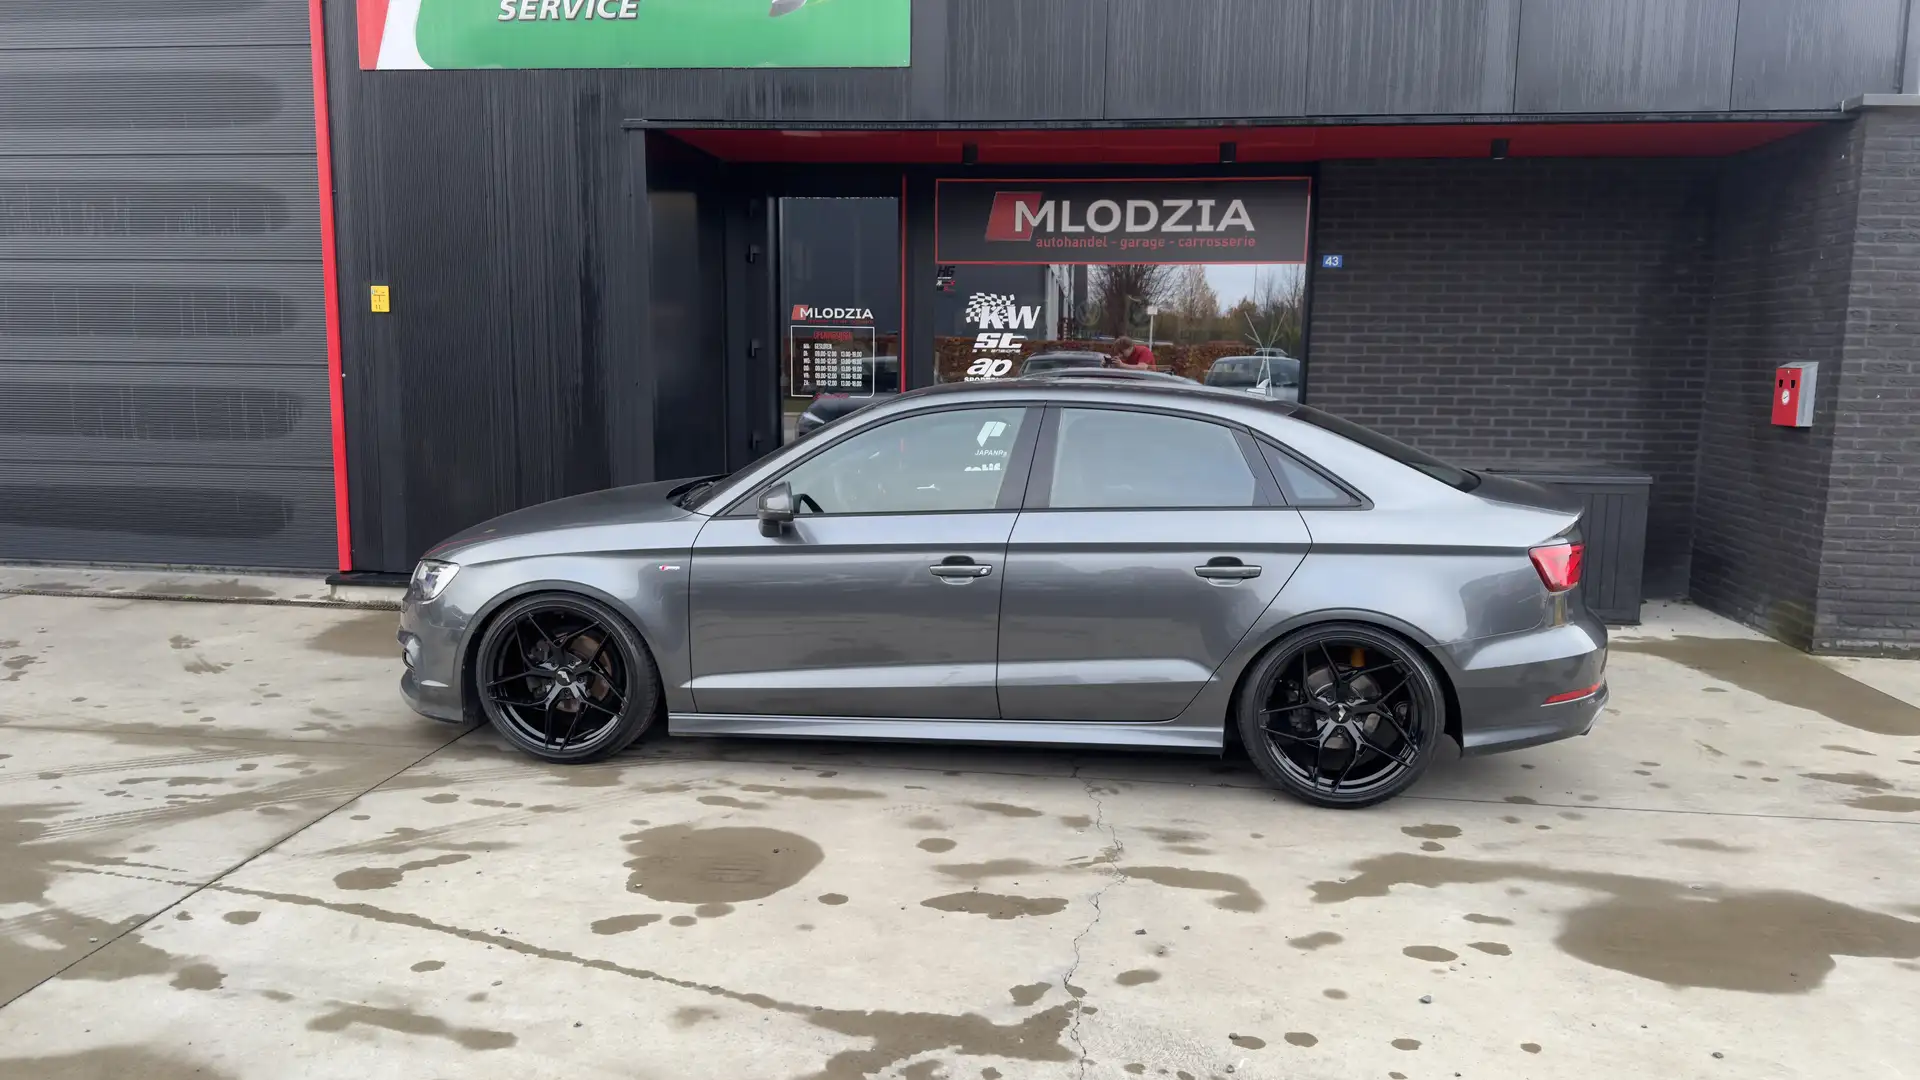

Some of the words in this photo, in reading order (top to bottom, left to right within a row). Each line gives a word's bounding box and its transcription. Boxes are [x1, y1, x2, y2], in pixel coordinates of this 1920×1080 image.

[498, 0, 639, 21] SERVICE
[1014, 199, 1256, 233] MLODZIA
[1036, 236, 1108, 248] autohandel
[1119, 238, 1165, 250] garage
[1178, 236, 1256, 248] carrosserie
[1325, 256, 1339, 266] 43
[800, 307, 874, 319] MLODZIA
[979, 305, 1042, 329] KW
[966, 358, 1013, 377] ap
